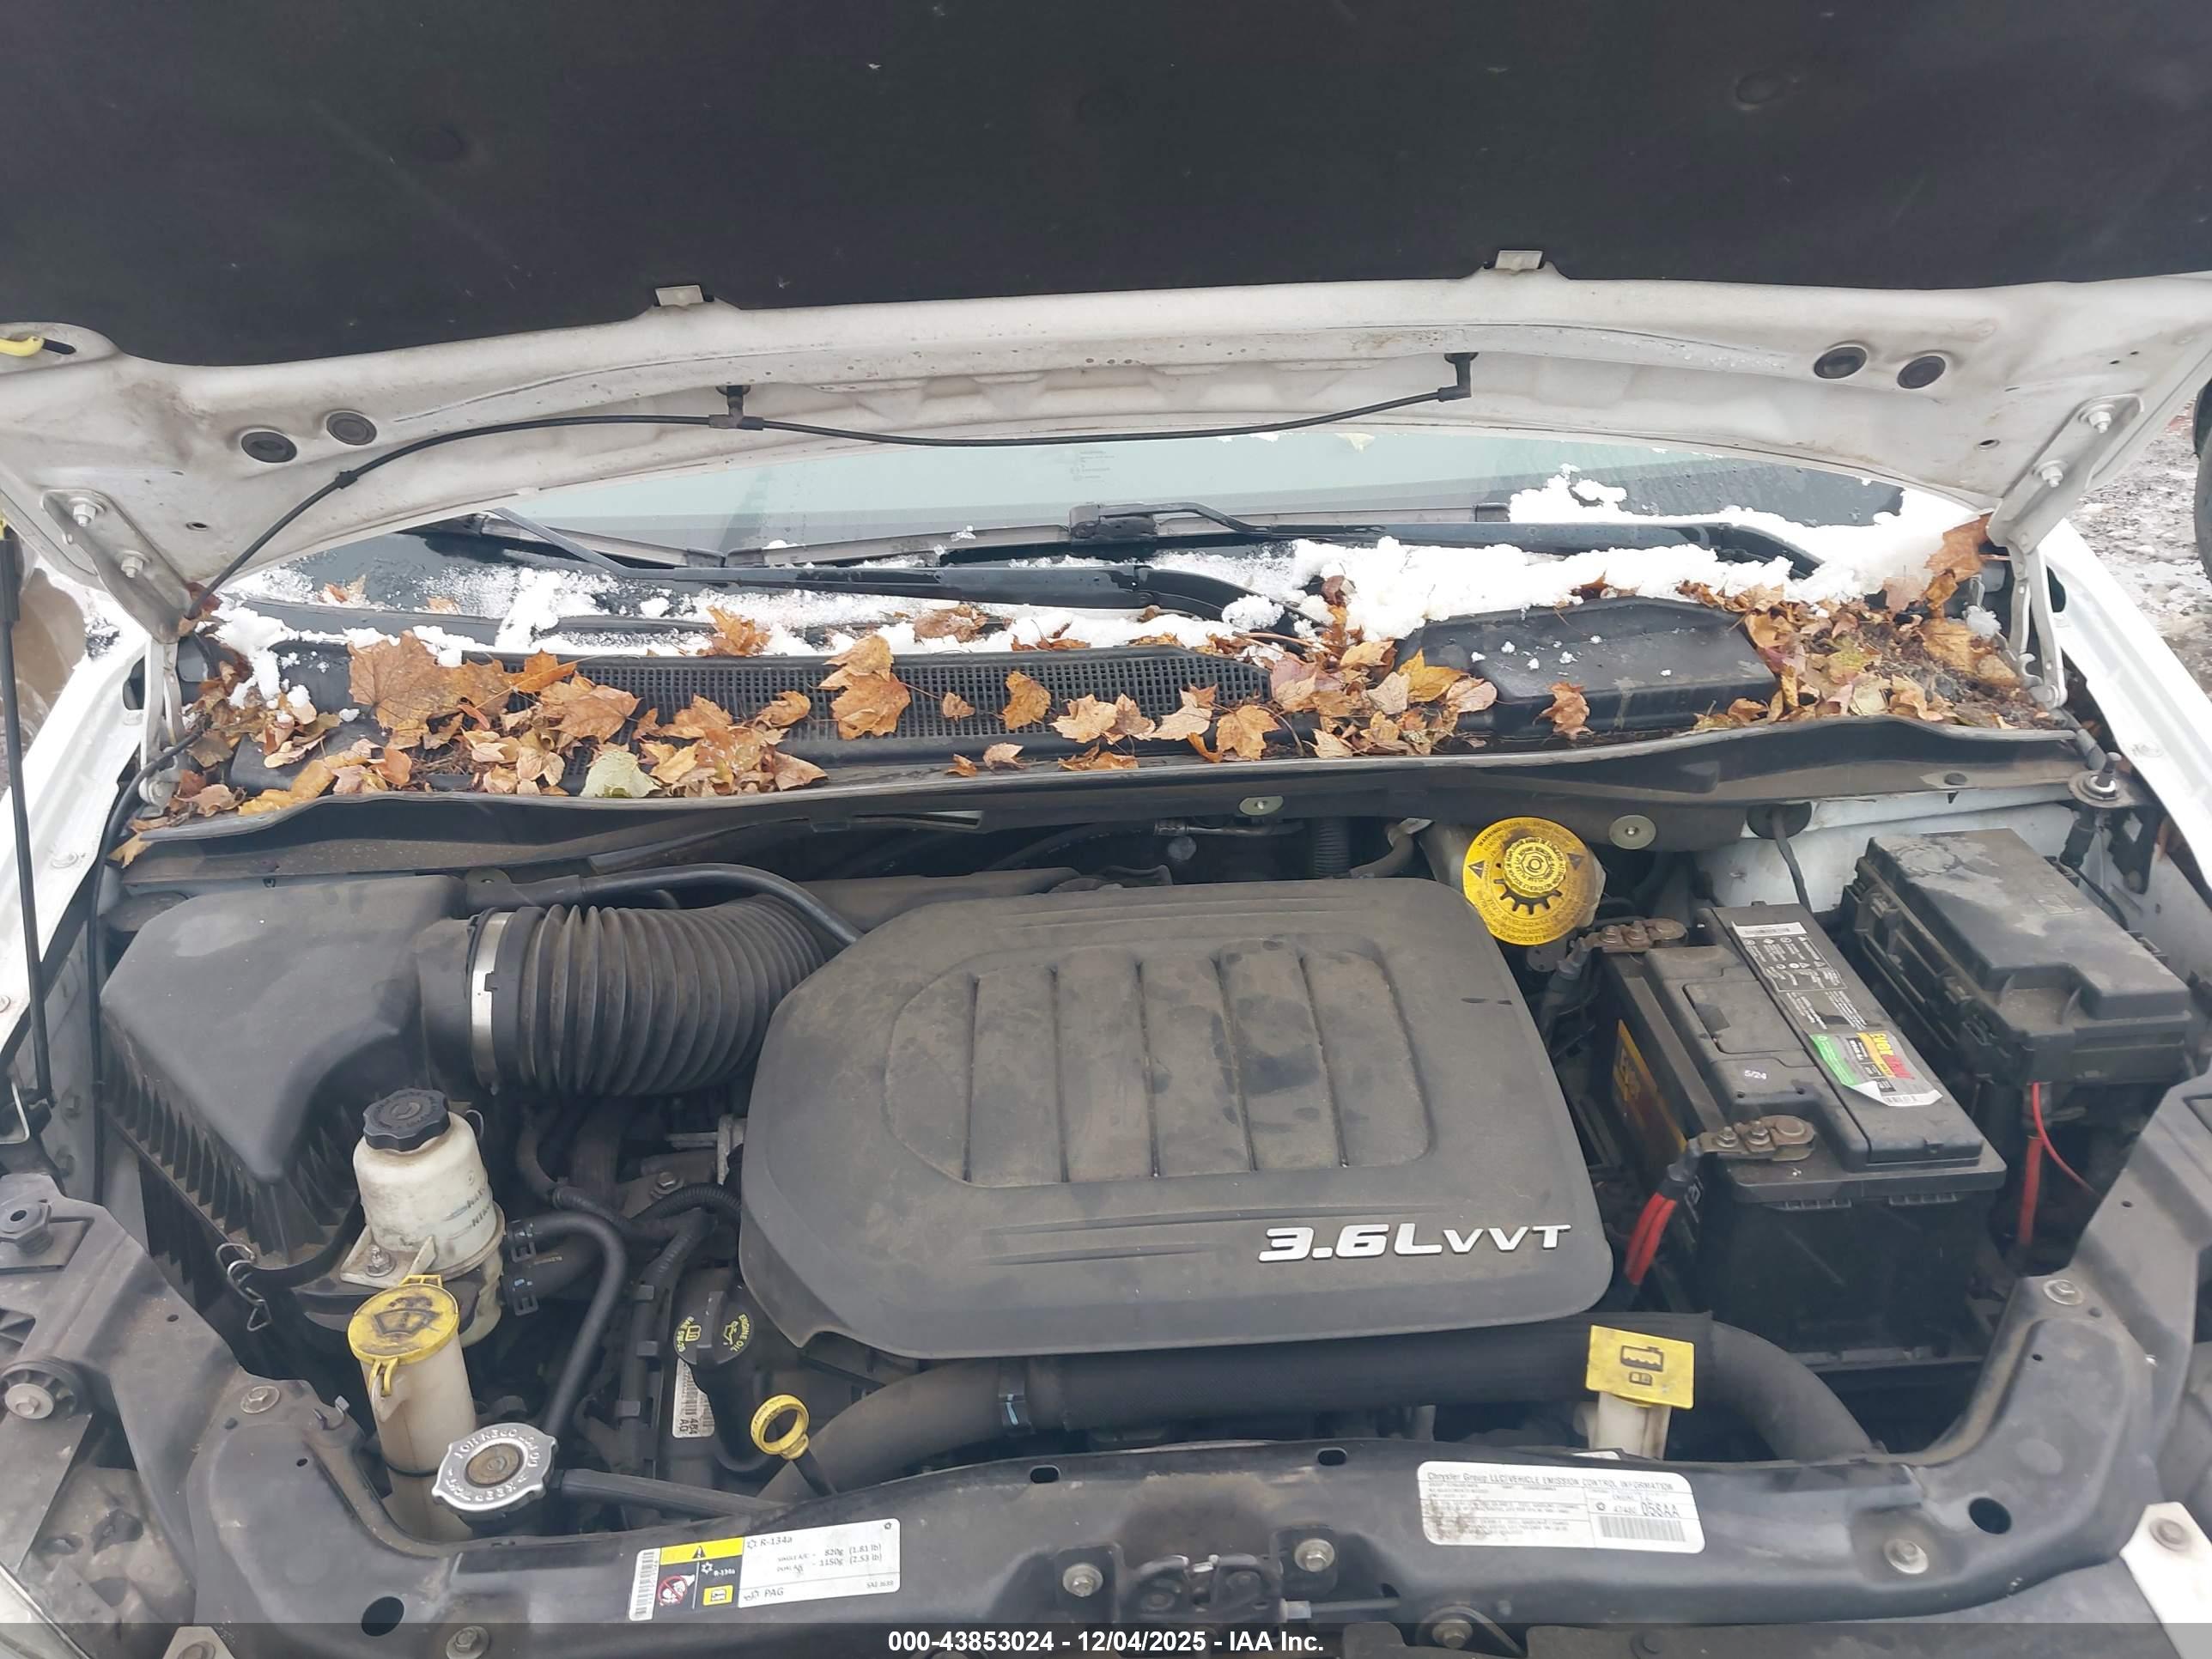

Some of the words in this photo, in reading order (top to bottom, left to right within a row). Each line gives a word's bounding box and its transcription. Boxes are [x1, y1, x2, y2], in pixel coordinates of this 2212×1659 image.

[738, 1313, 750, 1341] ENGINE
[730, 1340, 744, 1352] OIL
[759, 1535, 793, 1547] R-134a
[764, 1588, 784, 1598] PAG
